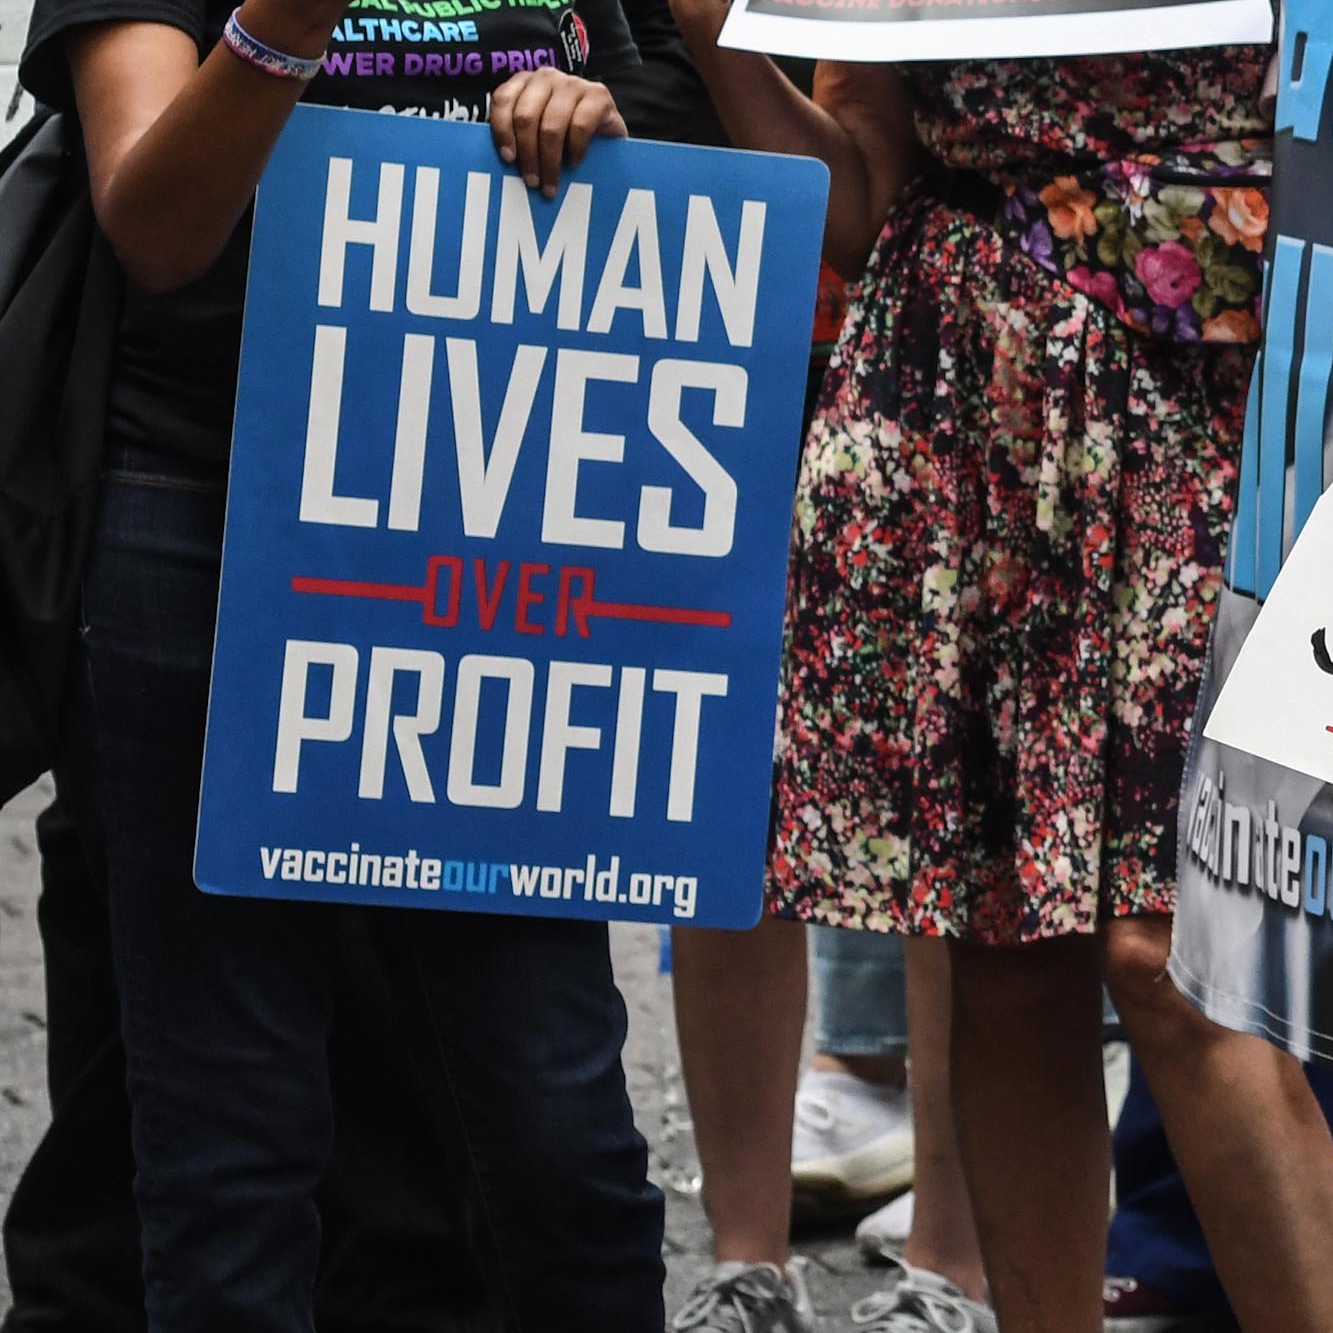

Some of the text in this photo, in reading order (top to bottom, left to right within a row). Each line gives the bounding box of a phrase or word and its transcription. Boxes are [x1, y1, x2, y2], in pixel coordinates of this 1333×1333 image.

[404, 53, 483, 76] DRUG
[317, 157, 766, 347] HUMAN
[298, 325, 750, 558] LIVES
[422, 555, 598, 638] OVER
[272, 639, 728, 822] PROFIT
[259, 844, 697, 918] vaccinateourworld.org
